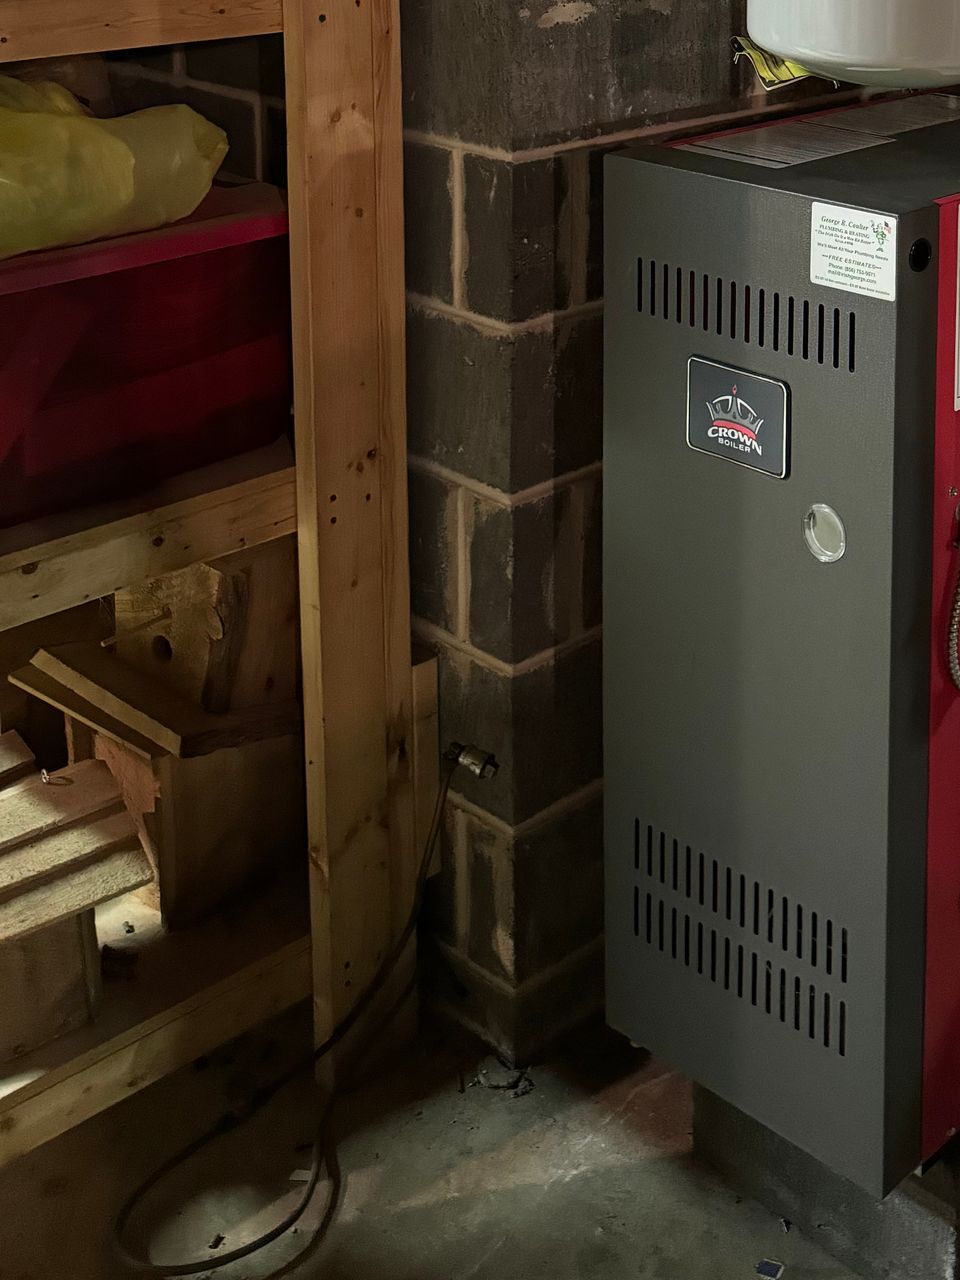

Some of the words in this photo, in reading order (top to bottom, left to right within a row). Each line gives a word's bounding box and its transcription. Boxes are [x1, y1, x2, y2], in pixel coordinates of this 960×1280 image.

[821, 216, 840, 225] George
[819, 224, 844, 233] PLUMBING
[707, 426, 762, 456] CROWN
[718, 438, 751, 453] BOILER
